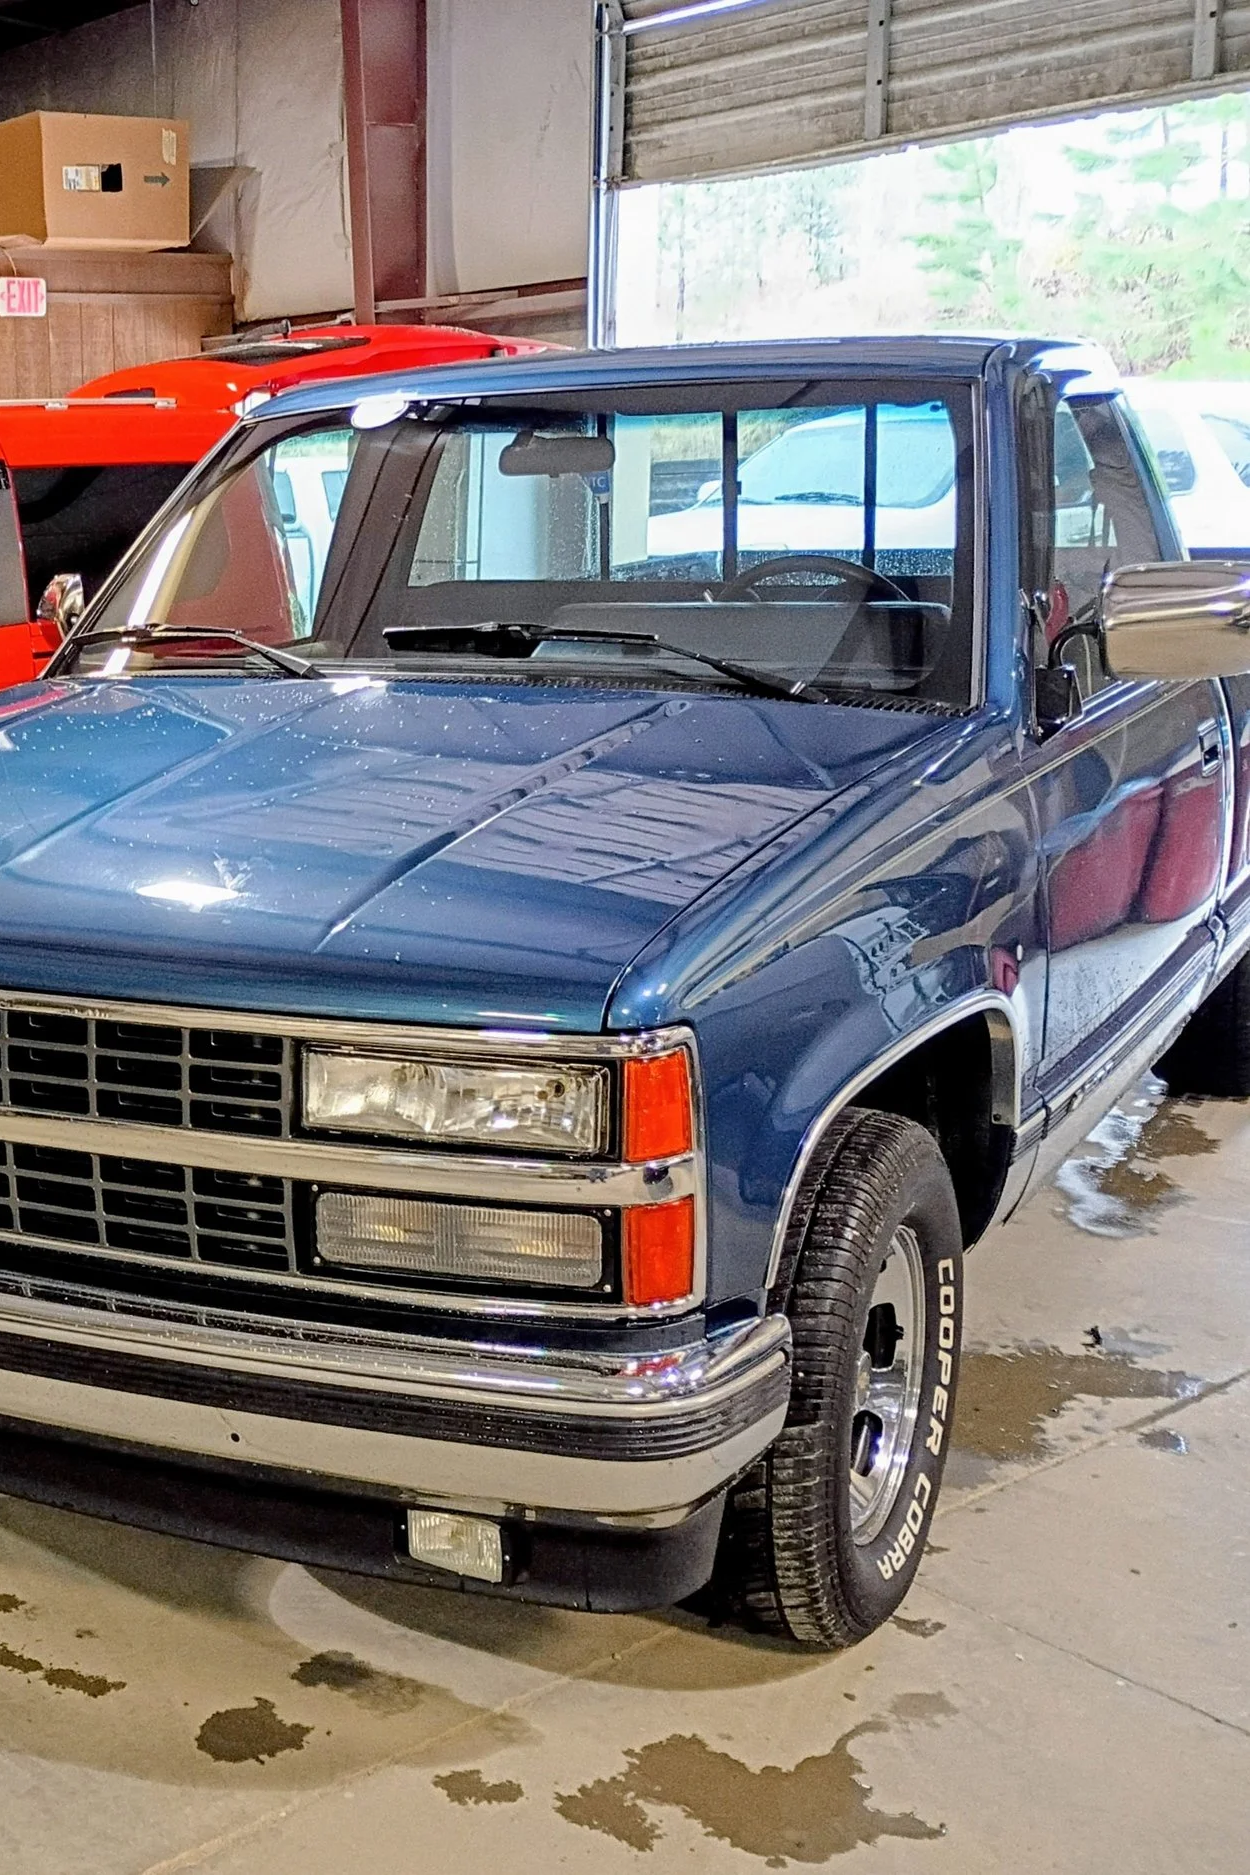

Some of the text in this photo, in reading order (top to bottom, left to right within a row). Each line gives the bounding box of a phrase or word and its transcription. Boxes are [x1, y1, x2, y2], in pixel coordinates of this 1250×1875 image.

[6, 280, 40, 313] EXIT
[877, 1258, 955, 1581] COOPER COBRA
